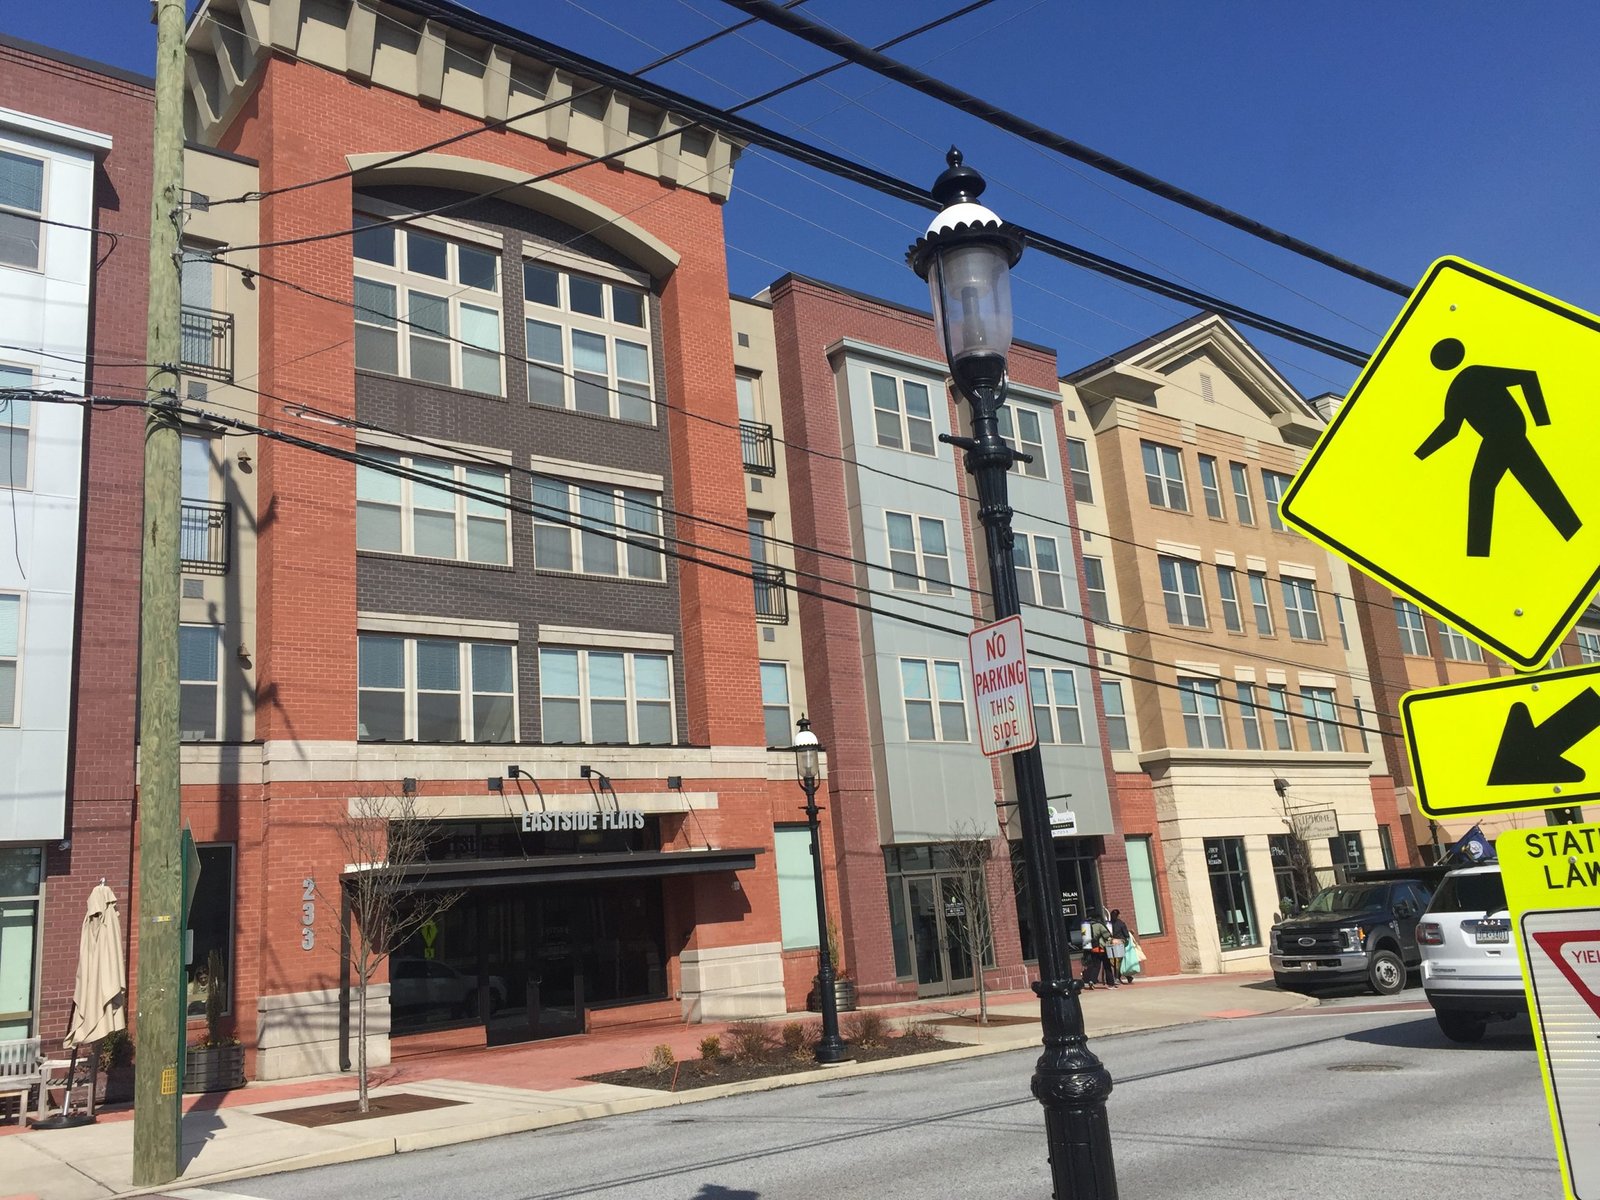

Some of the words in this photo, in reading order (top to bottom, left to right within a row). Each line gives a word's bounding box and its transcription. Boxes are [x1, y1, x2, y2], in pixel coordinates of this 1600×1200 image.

[986, 633, 1006, 661] NO
[976, 660, 1024, 696] PARKING
[990, 696, 1015, 716] THIS
[993, 720, 1019, 741] SIDE
[521, 809, 598, 833] EASTSIDE
[602, 809, 645, 830] FLATS
[1525, 828, 1600, 858] STAT
[1544, 861, 1600, 889] LAW
[302, 877, 315, 951] 233
